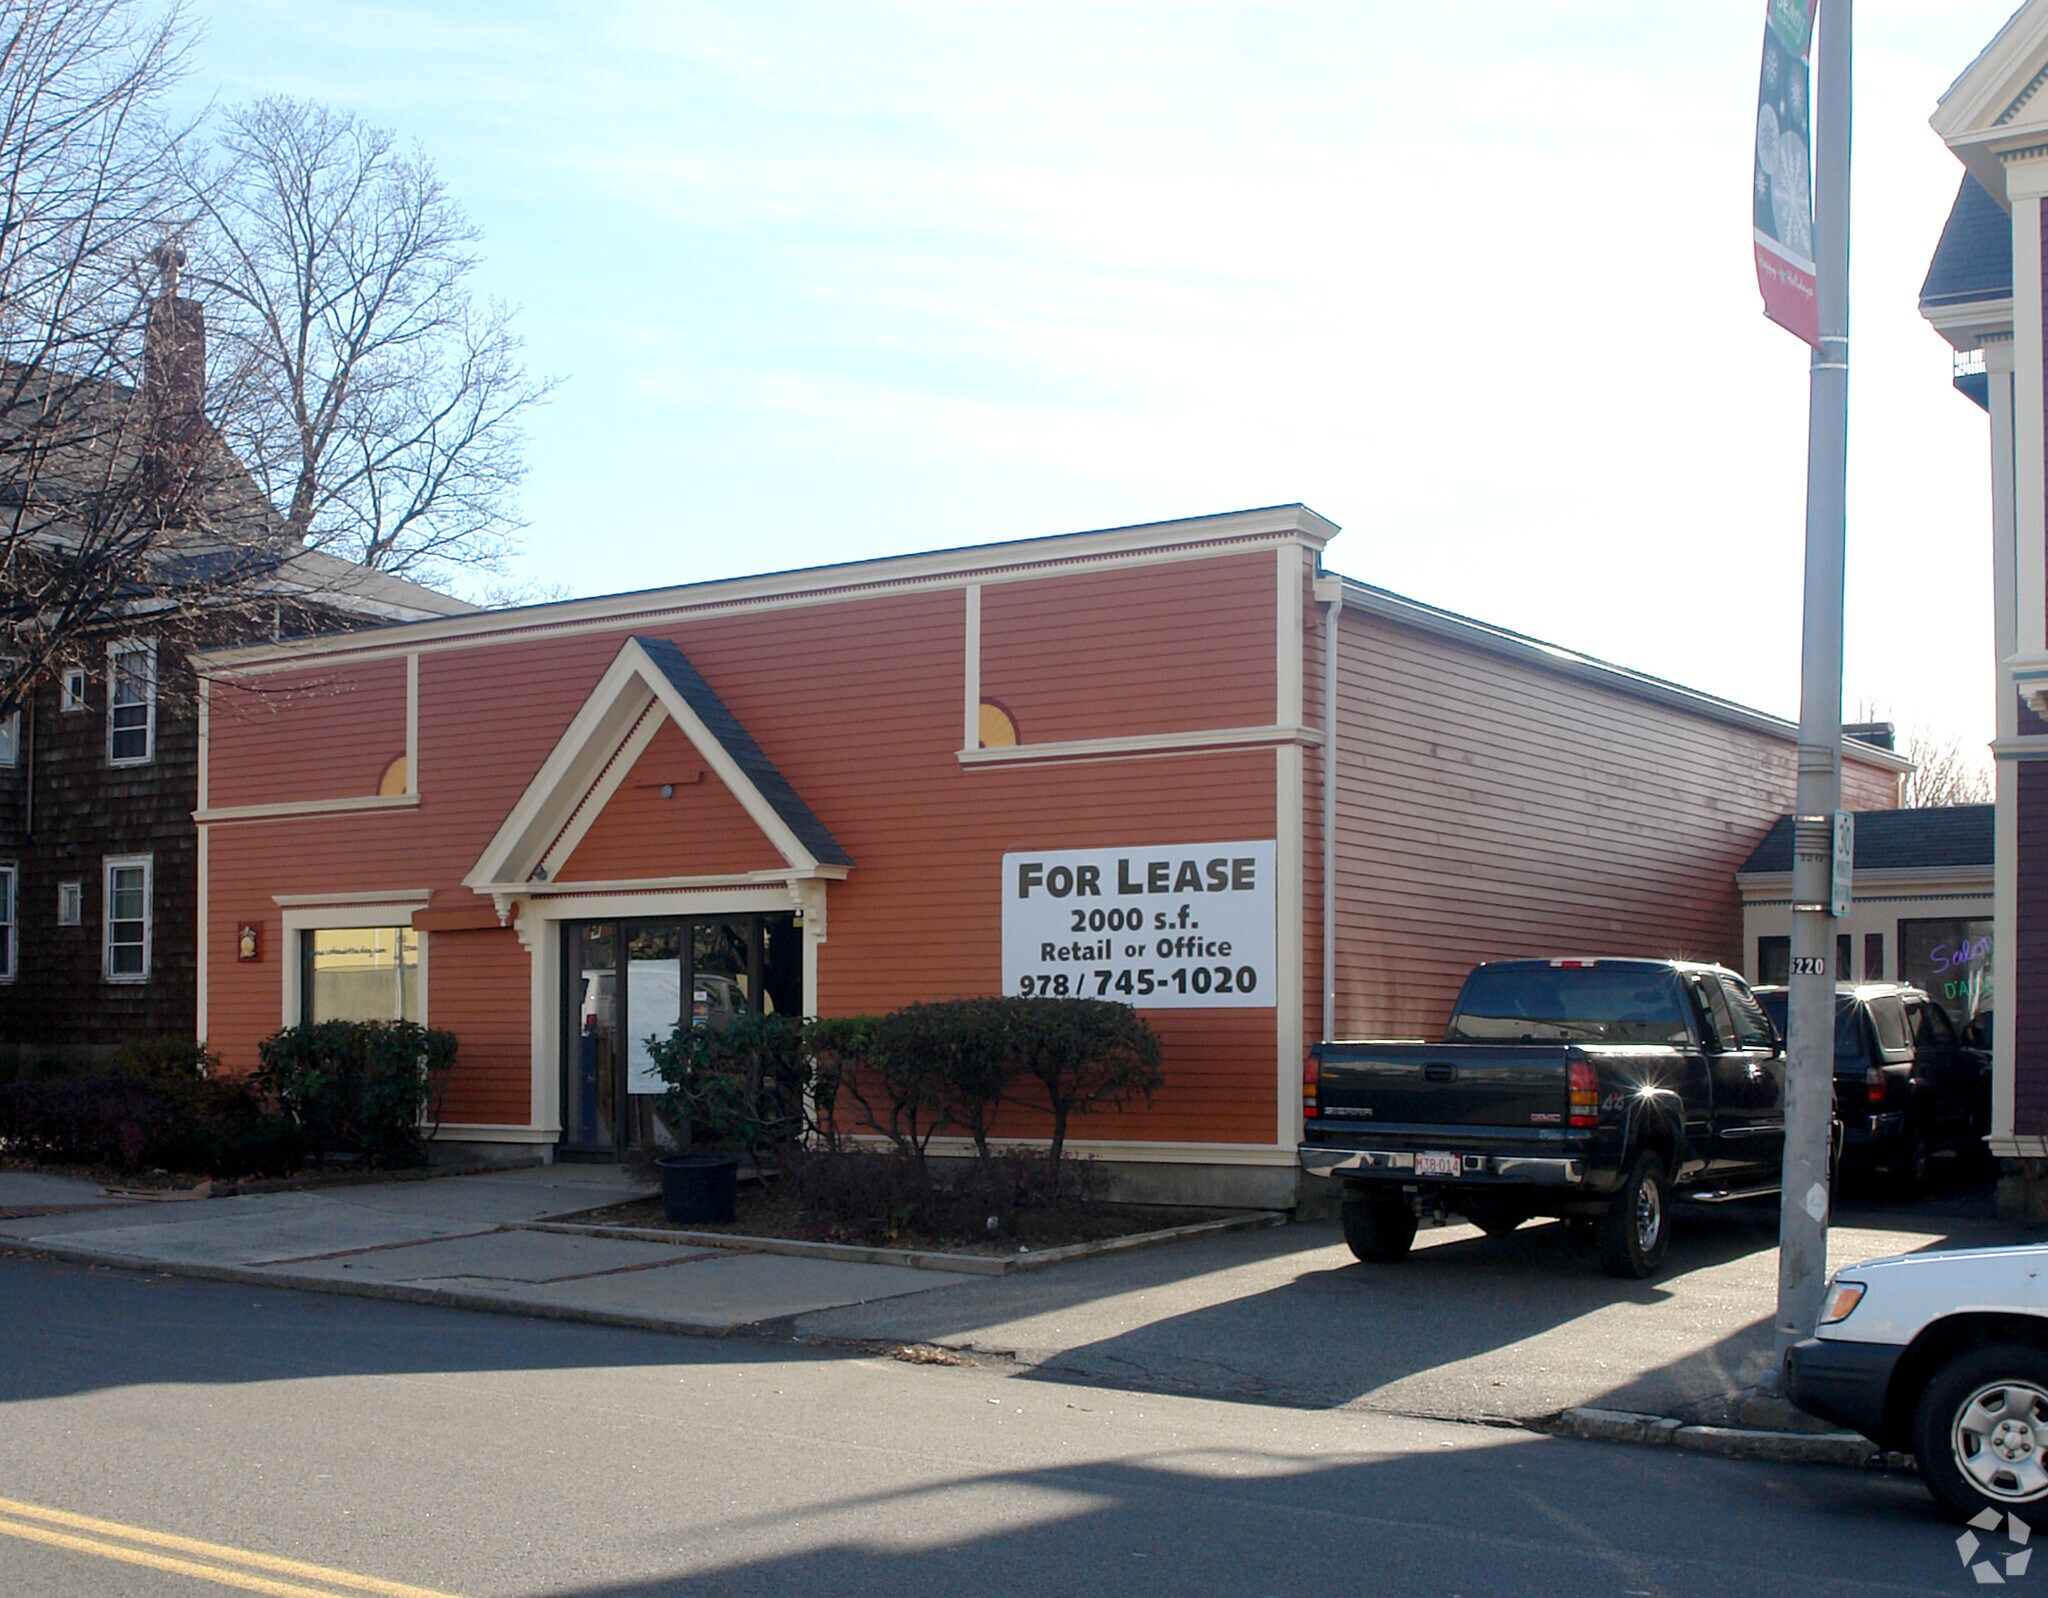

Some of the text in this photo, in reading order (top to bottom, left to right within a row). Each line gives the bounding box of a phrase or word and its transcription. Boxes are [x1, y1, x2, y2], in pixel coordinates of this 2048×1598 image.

[1018, 857, 1256, 898] FOR LEASE
[1071, 904, 1199, 932] 2000 s.f.
[1041, 936, 1232, 962] Retail or Office
